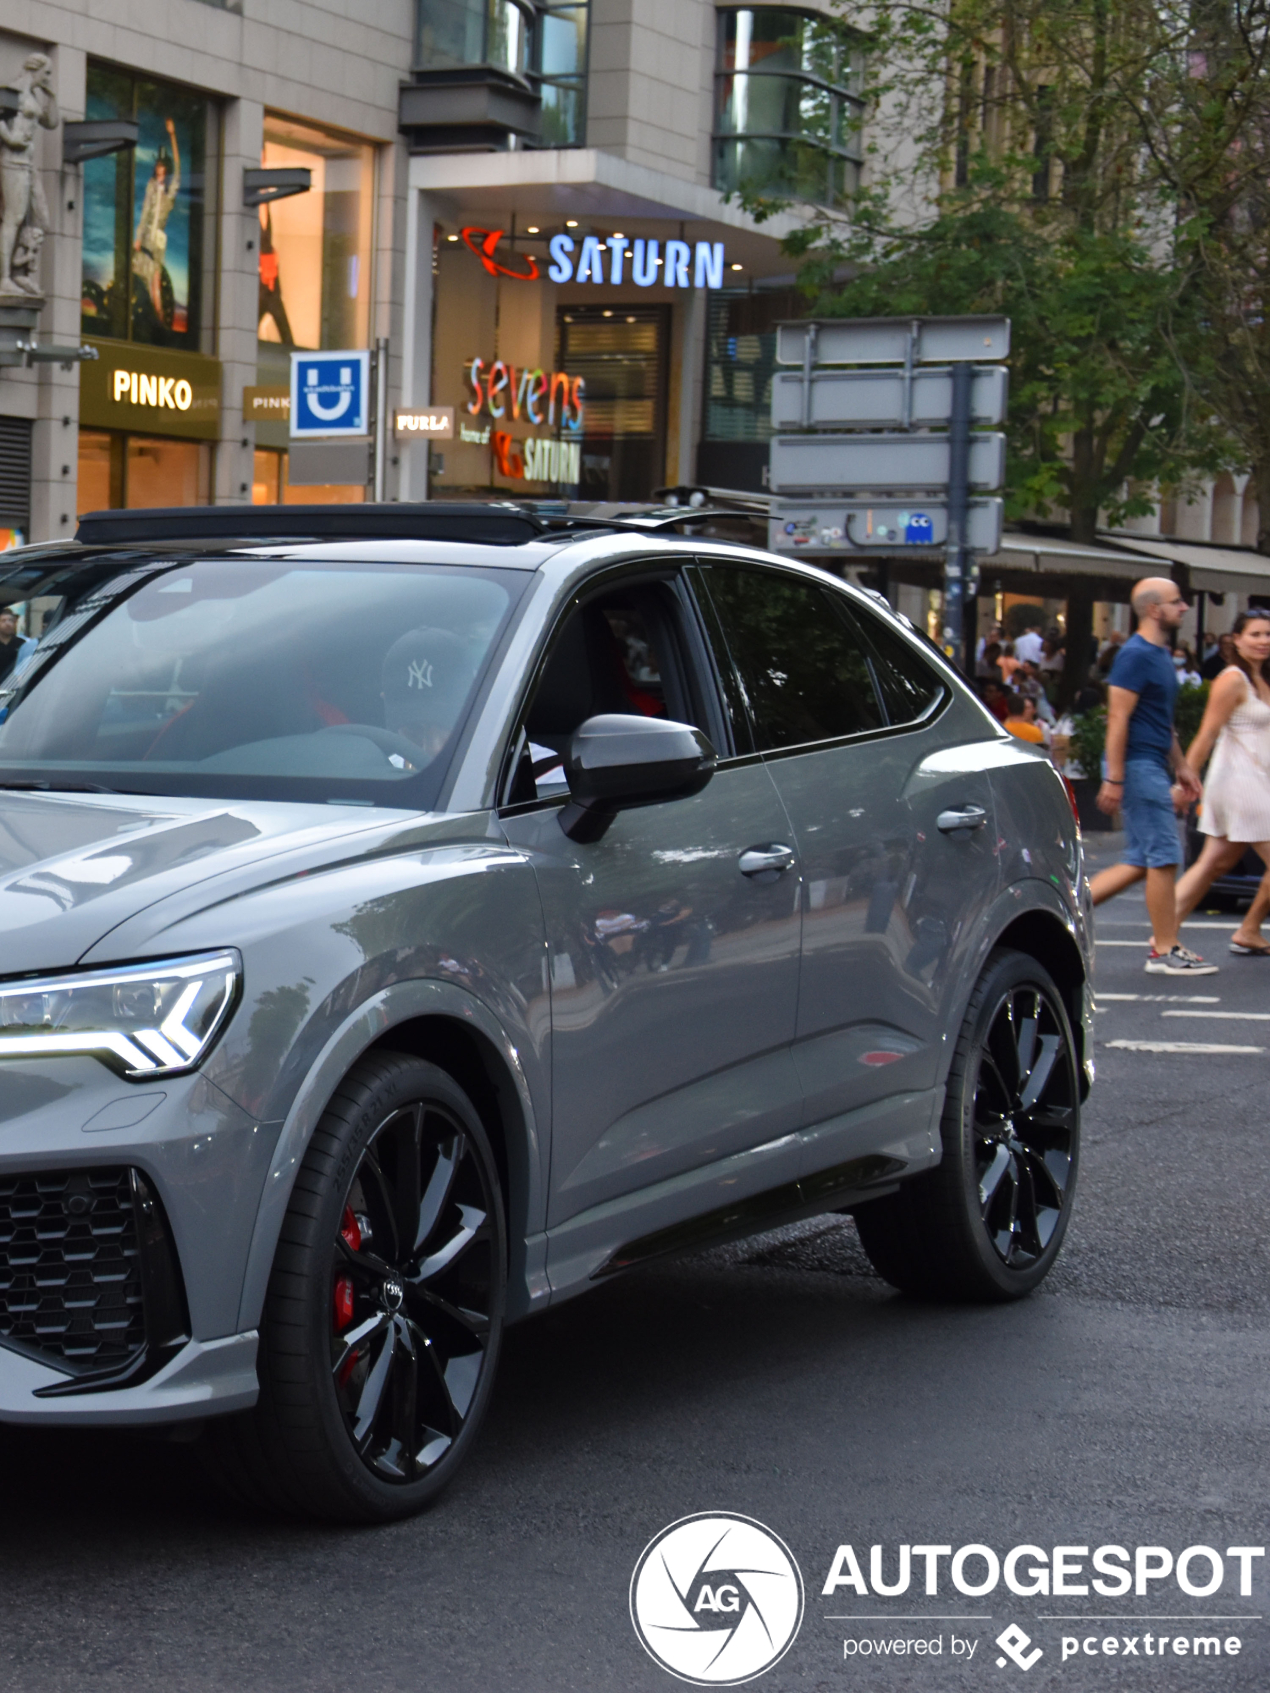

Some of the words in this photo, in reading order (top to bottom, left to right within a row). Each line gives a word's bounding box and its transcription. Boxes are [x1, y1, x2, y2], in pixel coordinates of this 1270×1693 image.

[548, 234, 724, 289] SATURN
[114, 369, 192, 411] PINKO
[466, 357, 585, 430] sevens
[397, 415, 449, 431] FURLA
[524, 437, 580, 484] SATURN
[408, 659, 433, 689] NY
